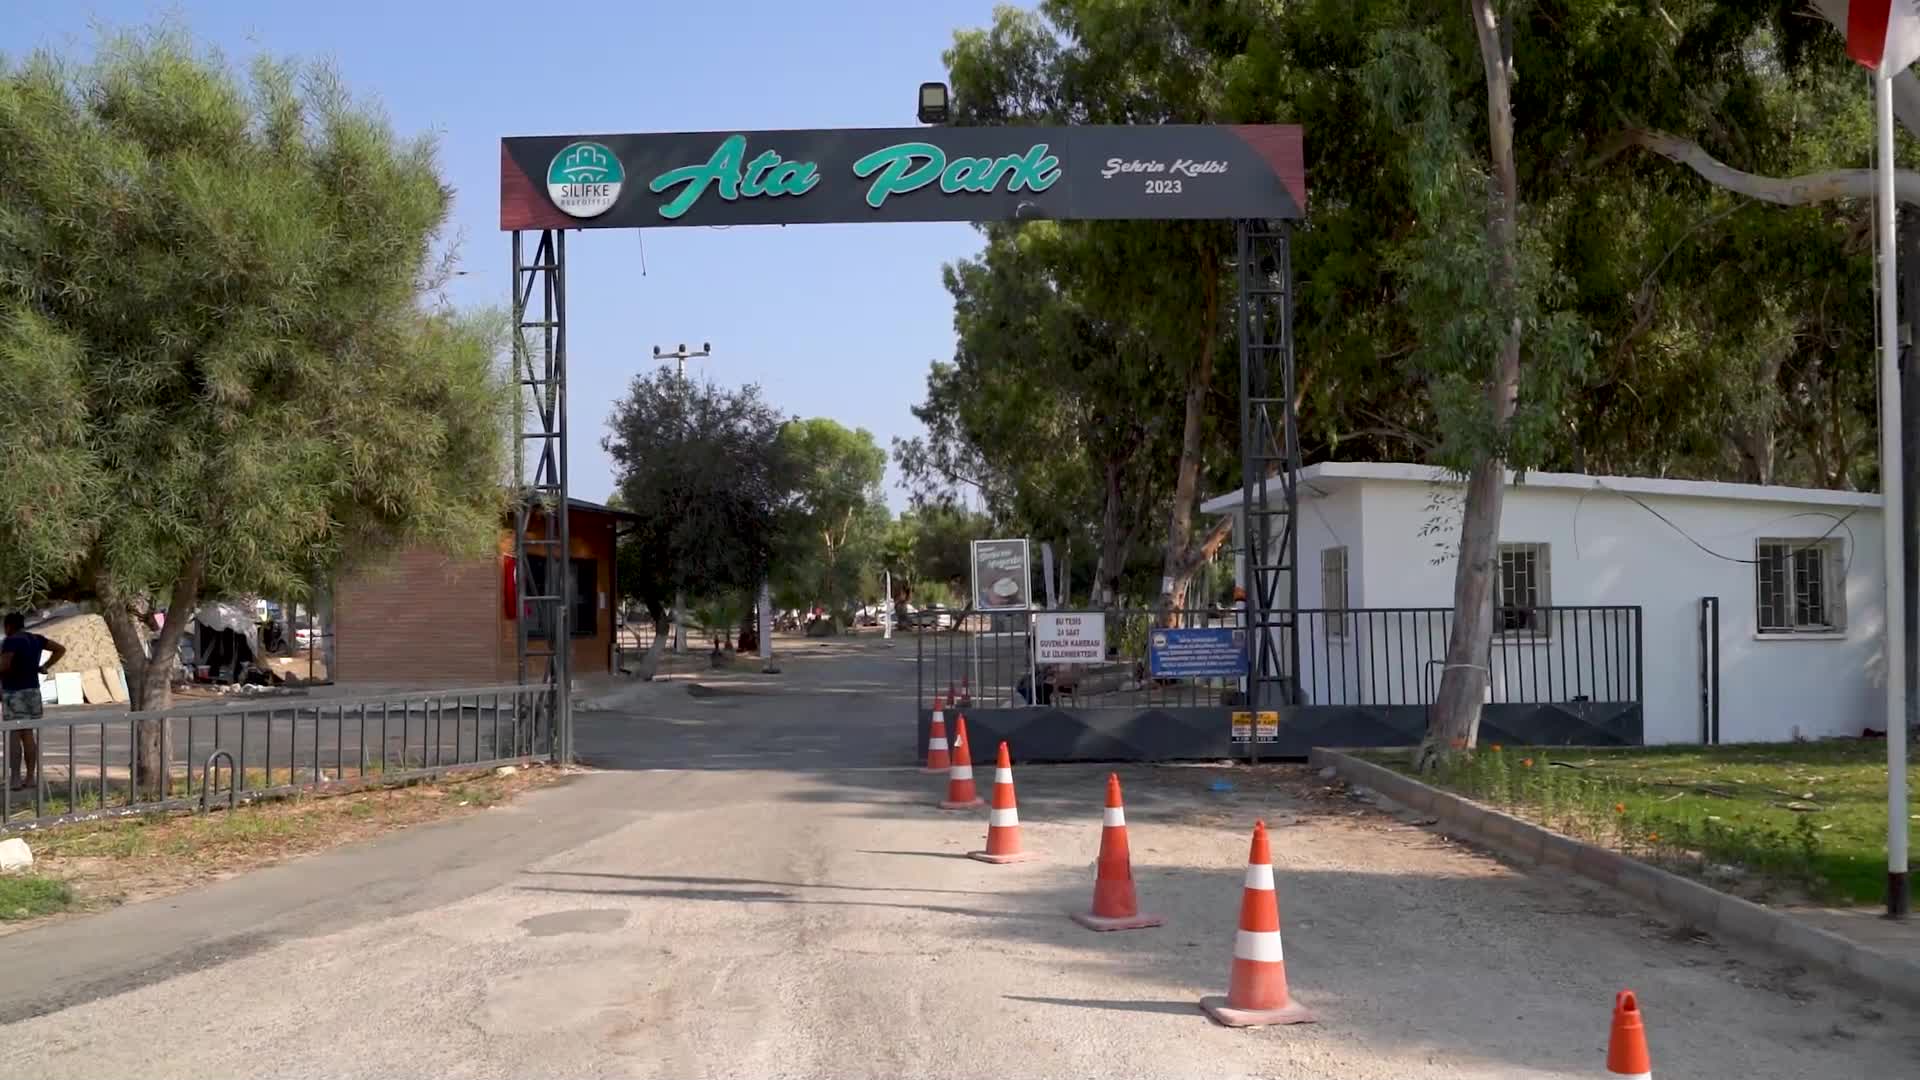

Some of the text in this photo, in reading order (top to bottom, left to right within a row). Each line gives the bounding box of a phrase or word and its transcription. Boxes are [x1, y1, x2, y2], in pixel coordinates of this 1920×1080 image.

[649, 134, 1063, 219] Ata Park
[1101, 157, 1228, 179] Şehrin Kalbi
[1145, 180, 1182, 194] 2023
